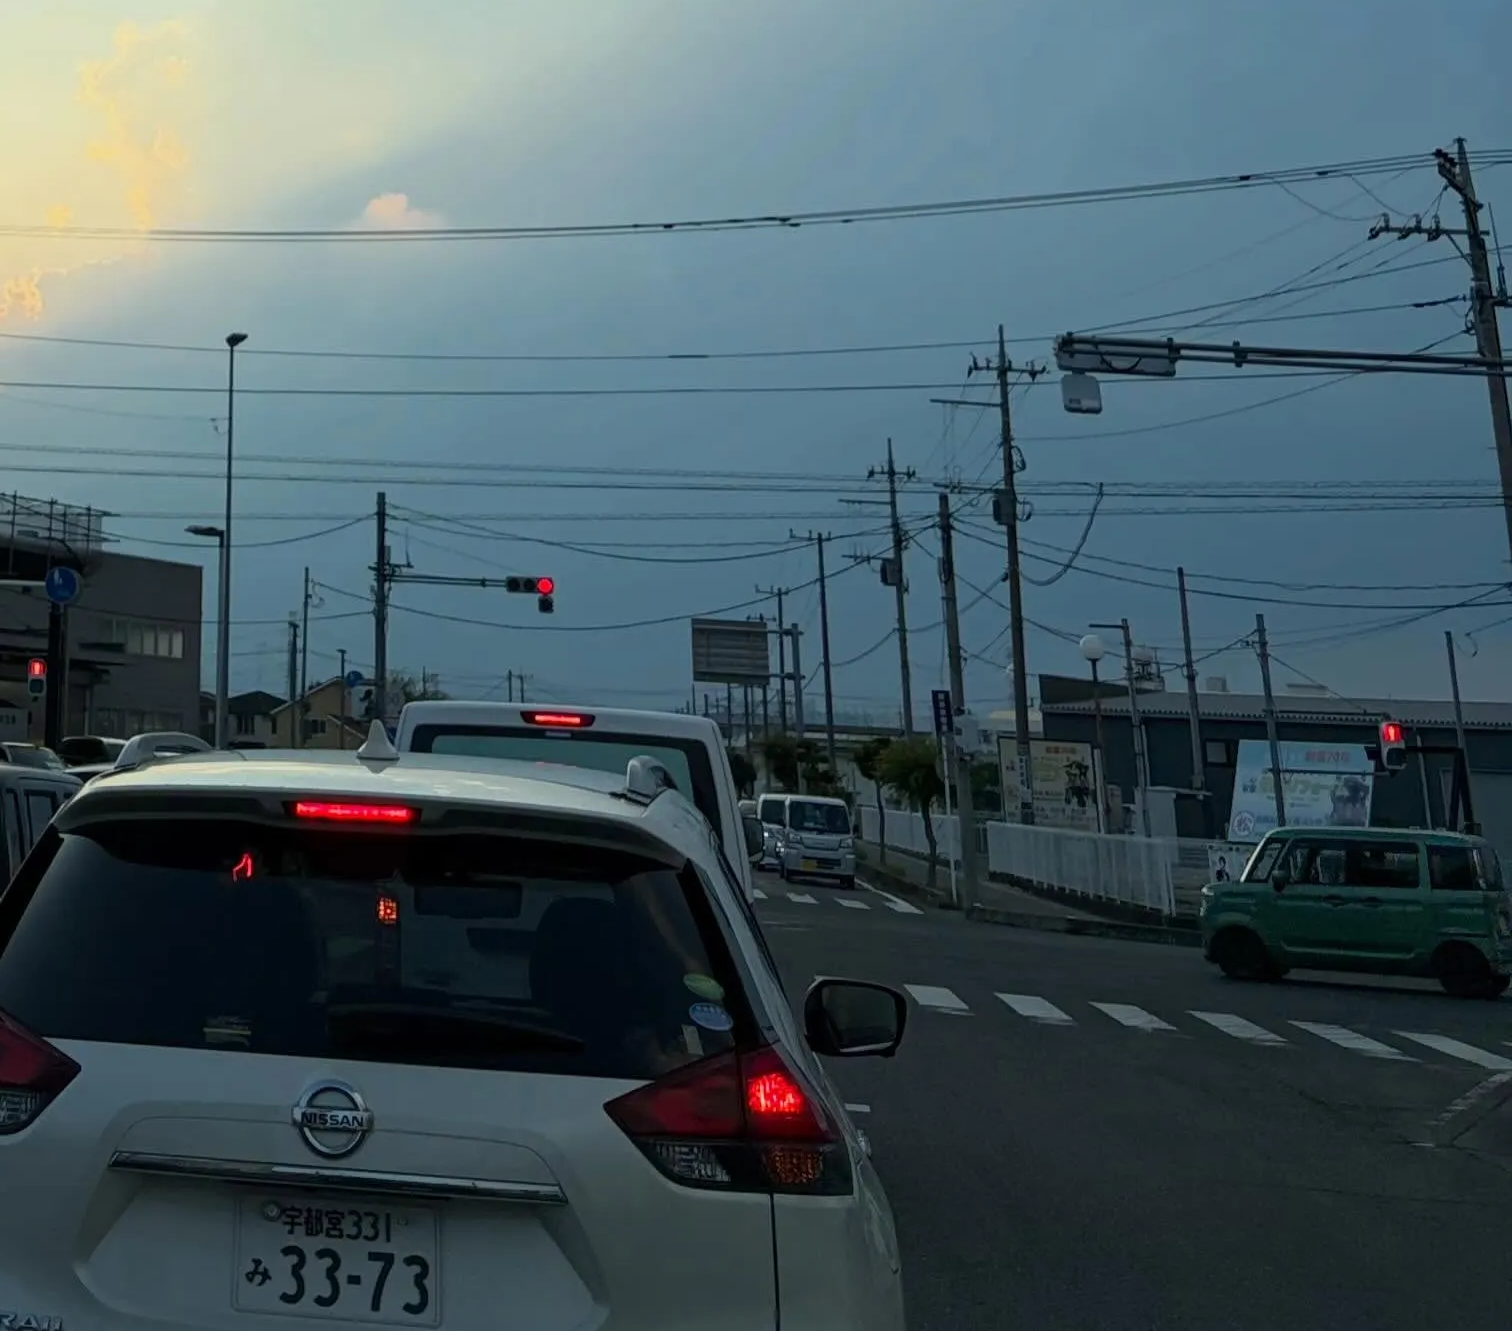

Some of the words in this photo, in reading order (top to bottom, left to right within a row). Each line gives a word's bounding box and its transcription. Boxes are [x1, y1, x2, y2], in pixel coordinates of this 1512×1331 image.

[302, 1111, 364, 1127] NISSAN
[245, 1257, 272, 1287] み
[279, 1245, 430, 1315] 33-73
